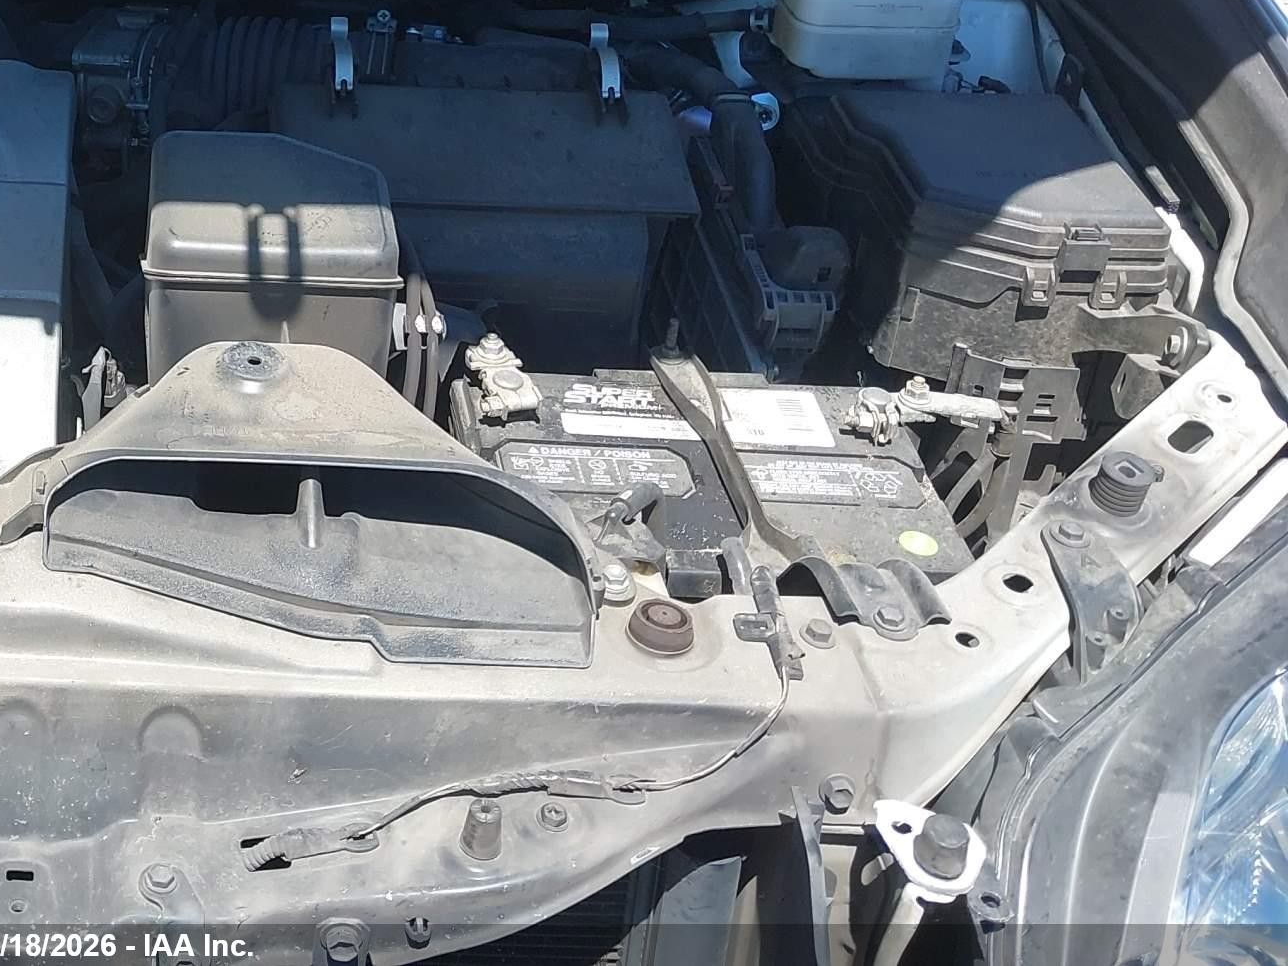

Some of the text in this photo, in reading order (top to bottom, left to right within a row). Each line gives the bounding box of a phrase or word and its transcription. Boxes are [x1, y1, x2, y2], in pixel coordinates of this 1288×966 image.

[562, 390, 656, 409] START
[572, 383, 653, 401] SUPER
[540, 446, 592, 457] DANGER
[603, 449, 651, 459] POISON
